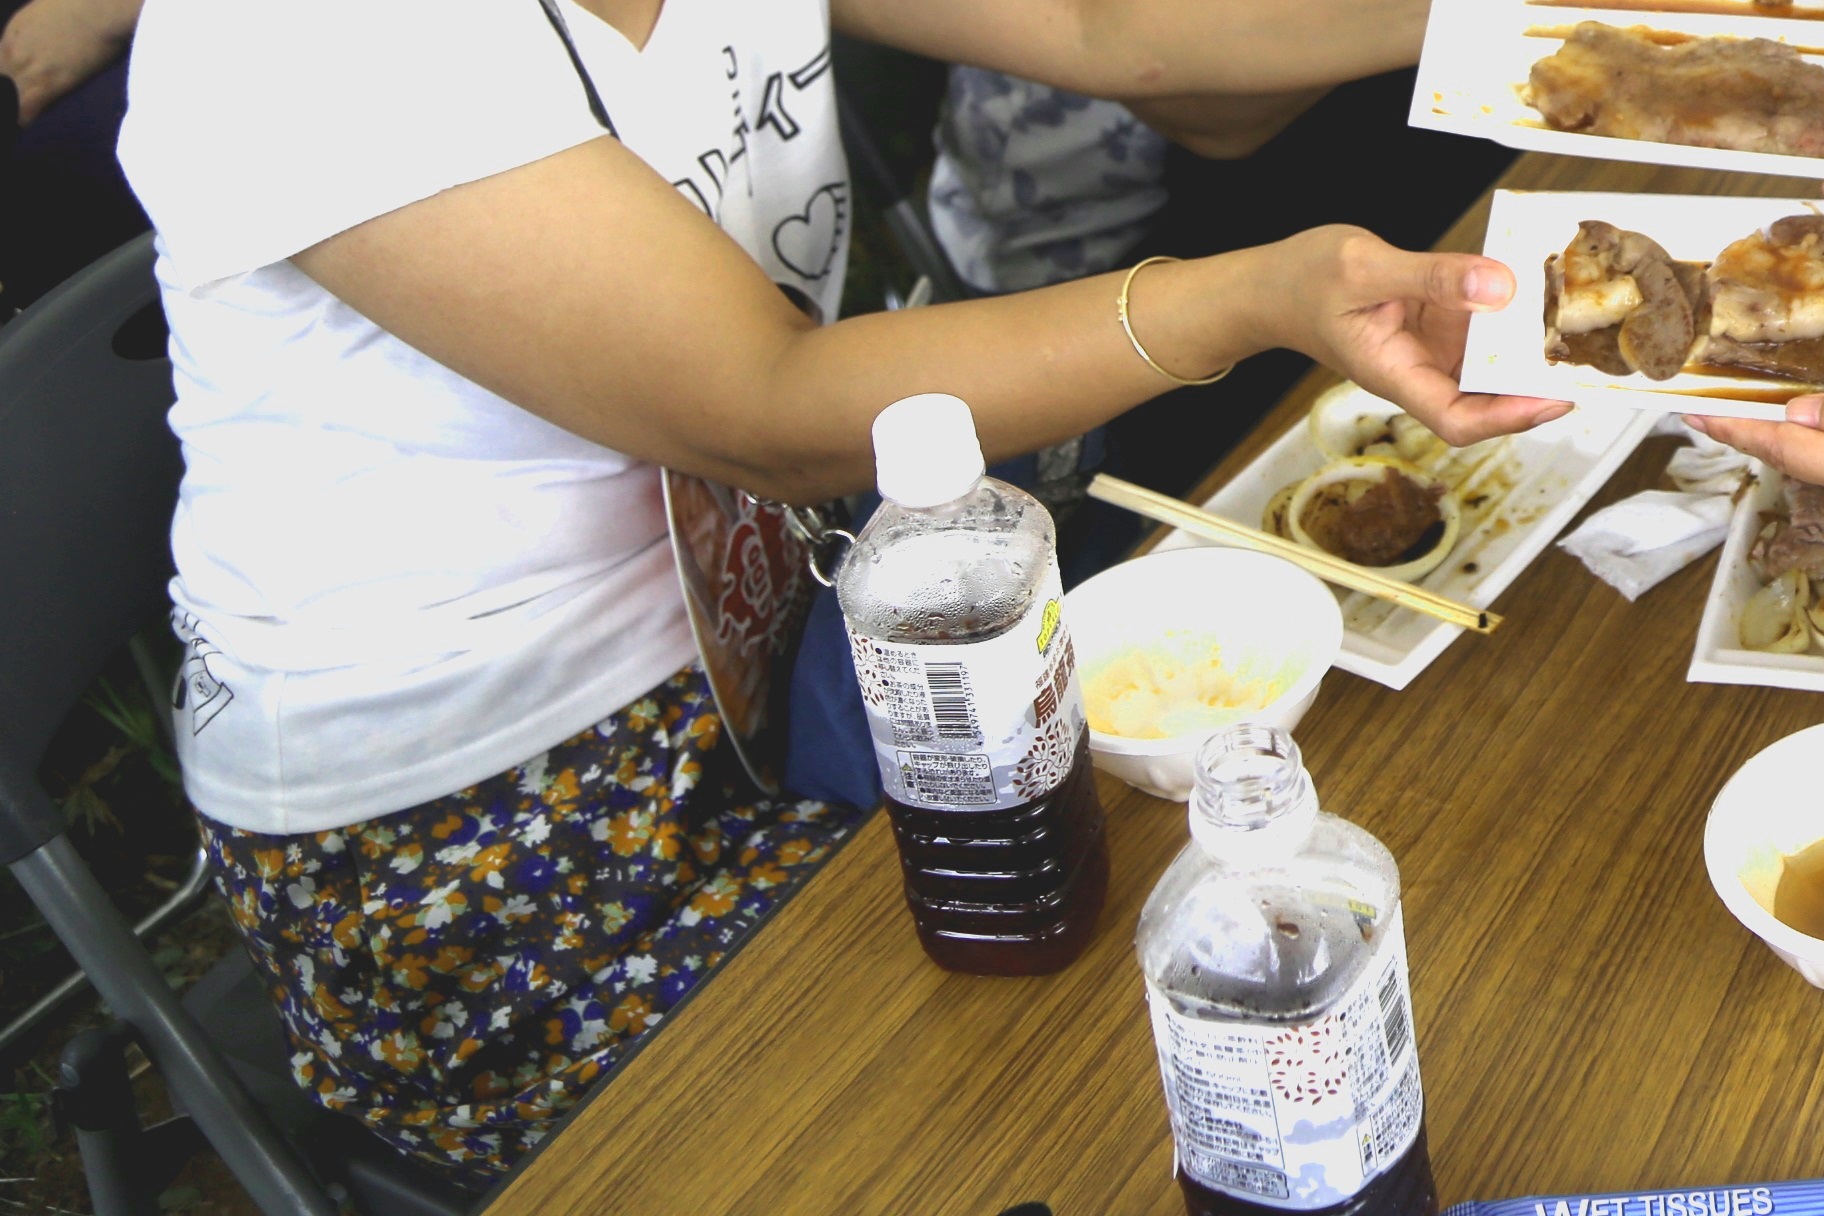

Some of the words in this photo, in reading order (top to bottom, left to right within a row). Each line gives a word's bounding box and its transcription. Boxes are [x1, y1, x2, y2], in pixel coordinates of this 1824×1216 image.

[1033, 634, 1076, 729] 烏龍茶
[1638, 1187, 1775, 1216] TISSUES
